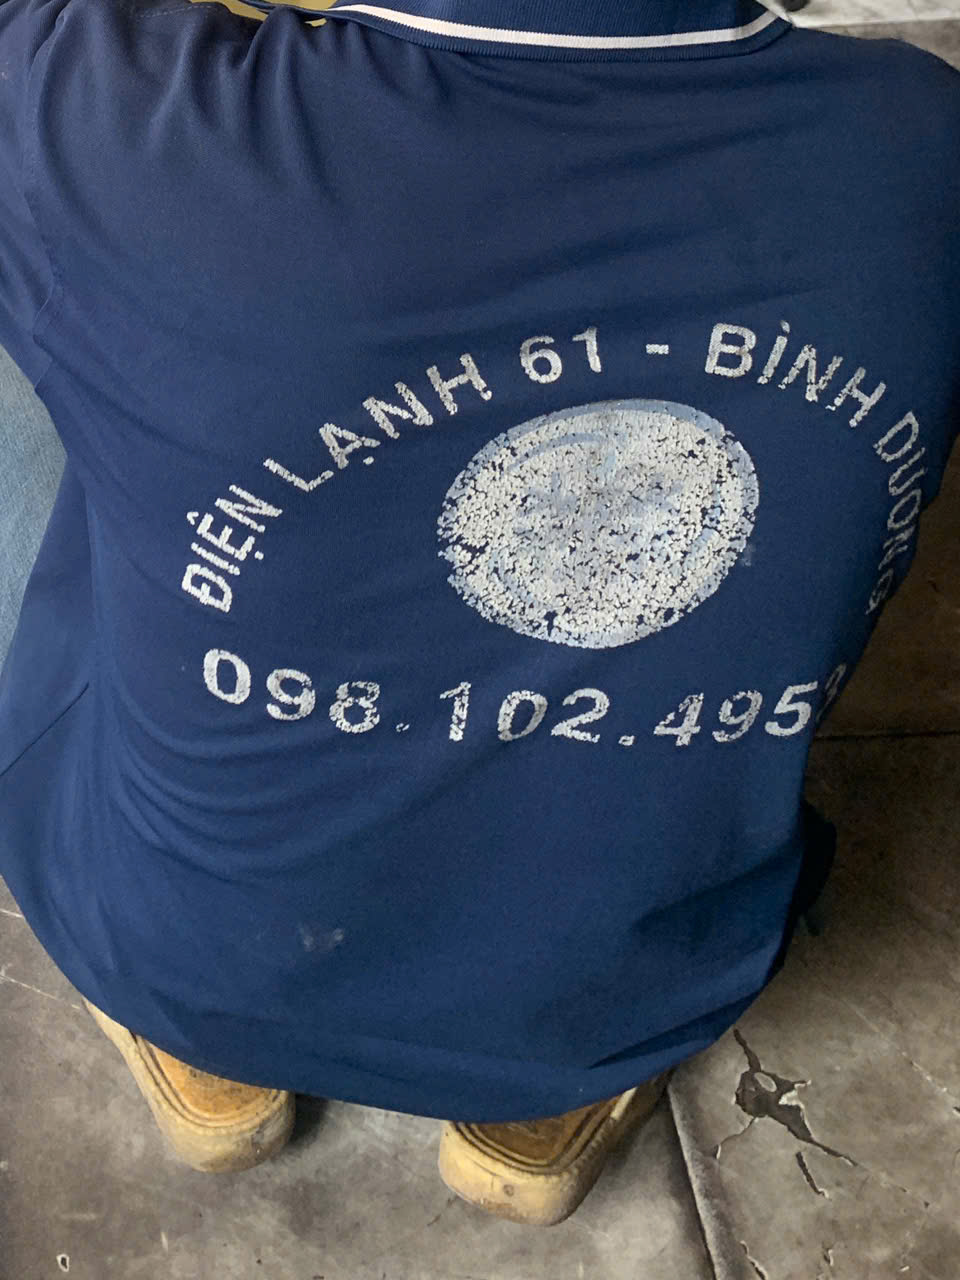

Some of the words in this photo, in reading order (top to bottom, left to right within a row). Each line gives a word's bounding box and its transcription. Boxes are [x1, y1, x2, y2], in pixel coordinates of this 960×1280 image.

[181, 484, 283, 613] ĐIỆN
[262, 352, 492, 492] LẠNH
[519, 325, 602, 384] 61
